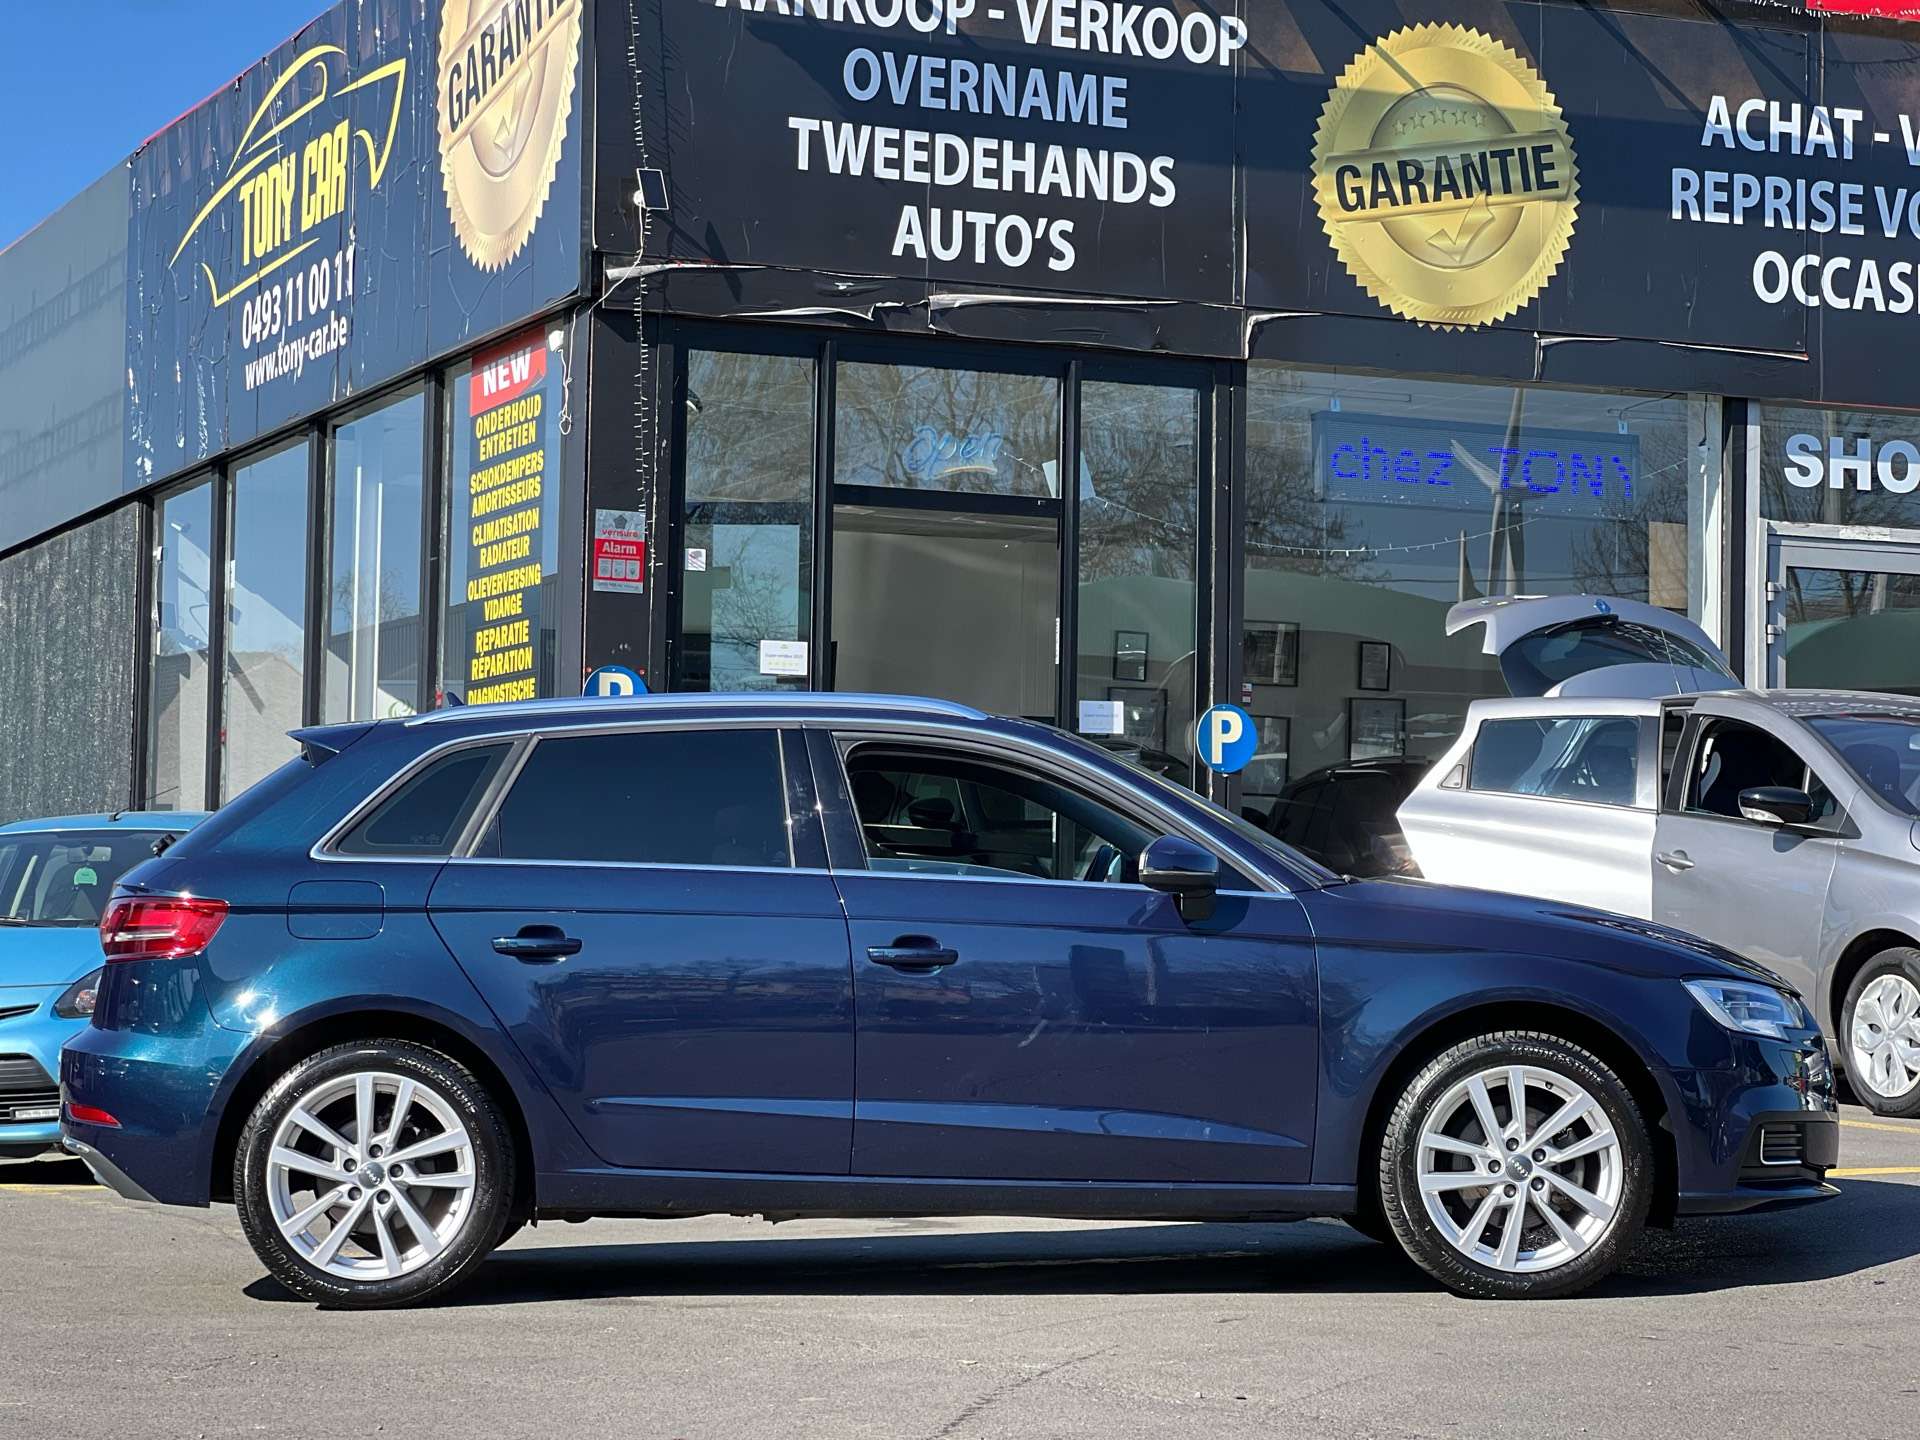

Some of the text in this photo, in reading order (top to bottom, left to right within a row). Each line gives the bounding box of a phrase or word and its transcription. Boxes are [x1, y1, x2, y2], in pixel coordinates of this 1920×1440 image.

[1017, 0, 1248, 67] VERKOOP
[447, 0, 564, 135] GARAN
[843, 47, 1128, 129] OVERNAME
[1701, 95, 1864, 161] ACHAT
[788, 116, 1176, 208] TWEEDEHANDS
[1334, 143, 1560, 213] GARANTIE
[239, 119, 349, 267] TONY CAR
[1671, 167, 1865, 237] REPRISE
[892, 205, 1076, 273] AUTO'S
[242, 243, 355, 350] 0493 11 00 11
[1752, 250, 1920, 314] OCCAS
[245, 309, 348, 391] www.tony-car.be
[482, 346, 532, 398] NEW
[475, 393, 542, 439] ONDERHOUD
[479, 420, 537, 462] ENTRETIEN
[470, 449, 544, 495] SCHOKDEMPERS
[1331, 436, 1455, 487] chez
[1783, 433, 1920, 494] SHO
[472, 475, 541, 518] AMORTISSEURS
[472, 507, 540, 547] CLIMATISATION
[479, 535, 530, 569] RADIATEUR
[602, 541, 638, 555] Alarm
[467, 563, 541, 602] OLIEVERVERSING
[484, 592, 523, 622] VIDANGE
[475, 619, 530, 654] REPARATIE
[471, 646, 533, 681] RÉPARATION
[467, 677, 536, 706] DIAGNOSTISCHE
[1211, 710, 1243, 764] P
